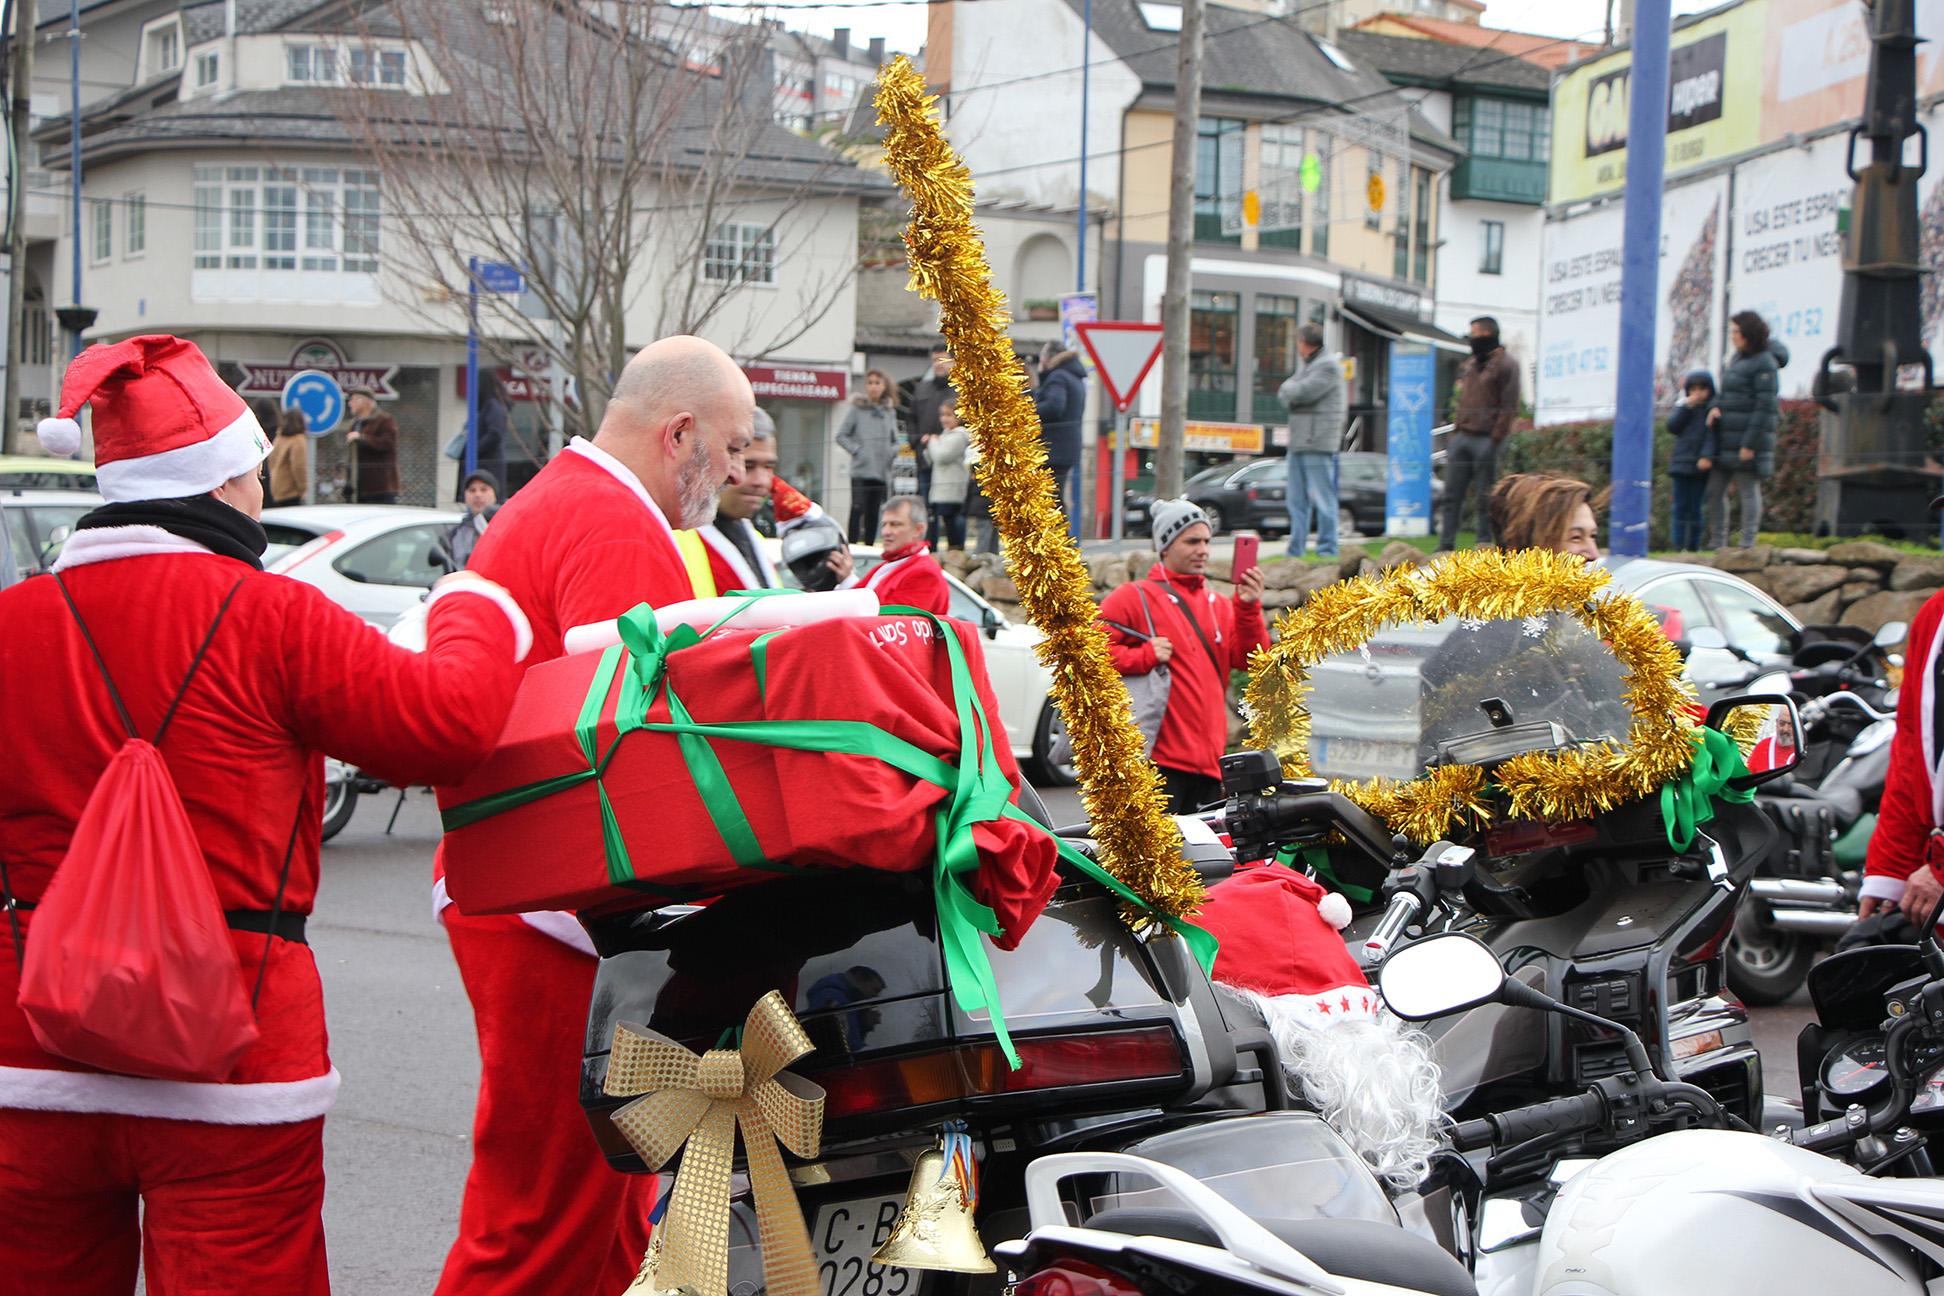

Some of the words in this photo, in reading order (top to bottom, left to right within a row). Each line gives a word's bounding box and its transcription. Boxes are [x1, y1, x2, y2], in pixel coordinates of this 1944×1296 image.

[1588, 72, 1631, 150] GA
[1806, 188, 1847, 222] ESPAC
[1743, 242, 1790, 273] CRECER
[1813, 230, 1841, 257] NEG
[252, 369, 382, 390] NUTRMA
[752, 382, 839, 398] ESPECIALIZADA
[774, 369, 817, 384] TIENDA
[823, 1201, 900, 1254] C-B
